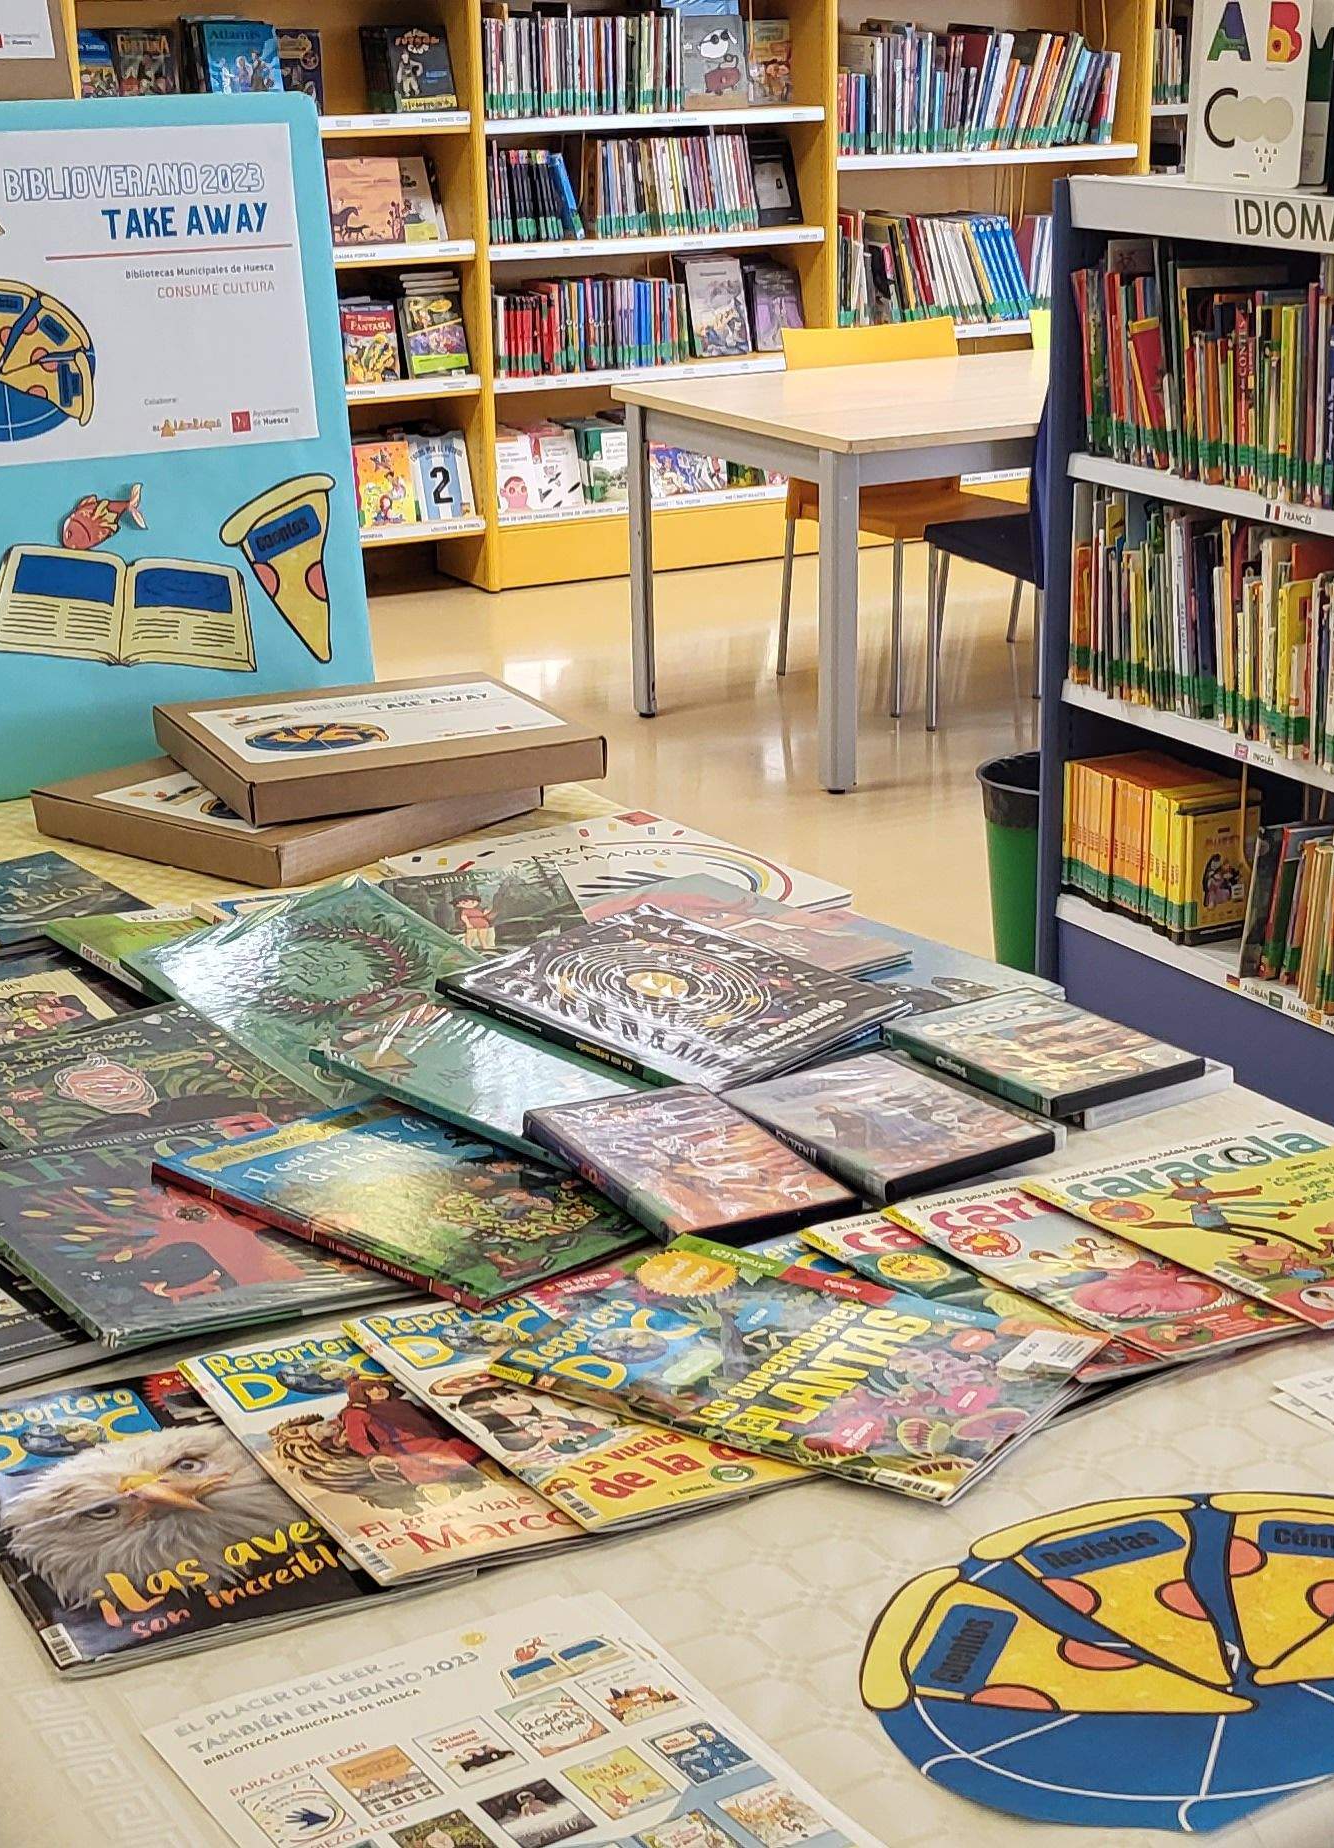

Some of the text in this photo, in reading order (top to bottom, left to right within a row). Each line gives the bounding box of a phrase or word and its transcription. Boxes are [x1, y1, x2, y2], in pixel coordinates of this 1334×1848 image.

[1207, 1, 1303, 63] A B
[4, 162, 265, 202] BIBLIOVERANO 2023
[101, 202, 269, 240] TAKE AWAY
[125, 263, 275, 280] Bibliotecas Municipales de Huesca
[157, 280, 275, 299] CONSUME CULTURA
[430, 466, 454, 504] 2
[1282, 510, 1313, 526] FRANCÉS
[1252, 751, 1275, 768] INGLÉS
[768, 999, 849, 1038] segundo
[1067, 1131, 1333, 1202] caracola
[570, 1456, 607, 1477] La
[608, 1432, 685, 1462] vuelta
[589, 1468, 657, 1500] de
[654, 1450, 706, 1481] la
[357, 1520, 387, 1539] El
[471, 1492, 535, 1520] viaje
[376, 1534, 406, 1551] de
[1042, 1529, 1161, 1569] Revistas
[130, 1606, 192, 1640] son
[172, 1663, 381, 1739] EL PLACER DE LEER
[188, 1650, 480, 1755] TAMBIÉN EN VERANO 2023
[203, 1687, 422, 1767] BIBLIOTECAS MUNICIPALES DE HUESCA
[229, 1778, 269, 1797] PARA
[305, 1756, 327, 1769] ME
[326, 1742, 367, 1761] LEAN
[368, 1813, 408, 1831] LEER
